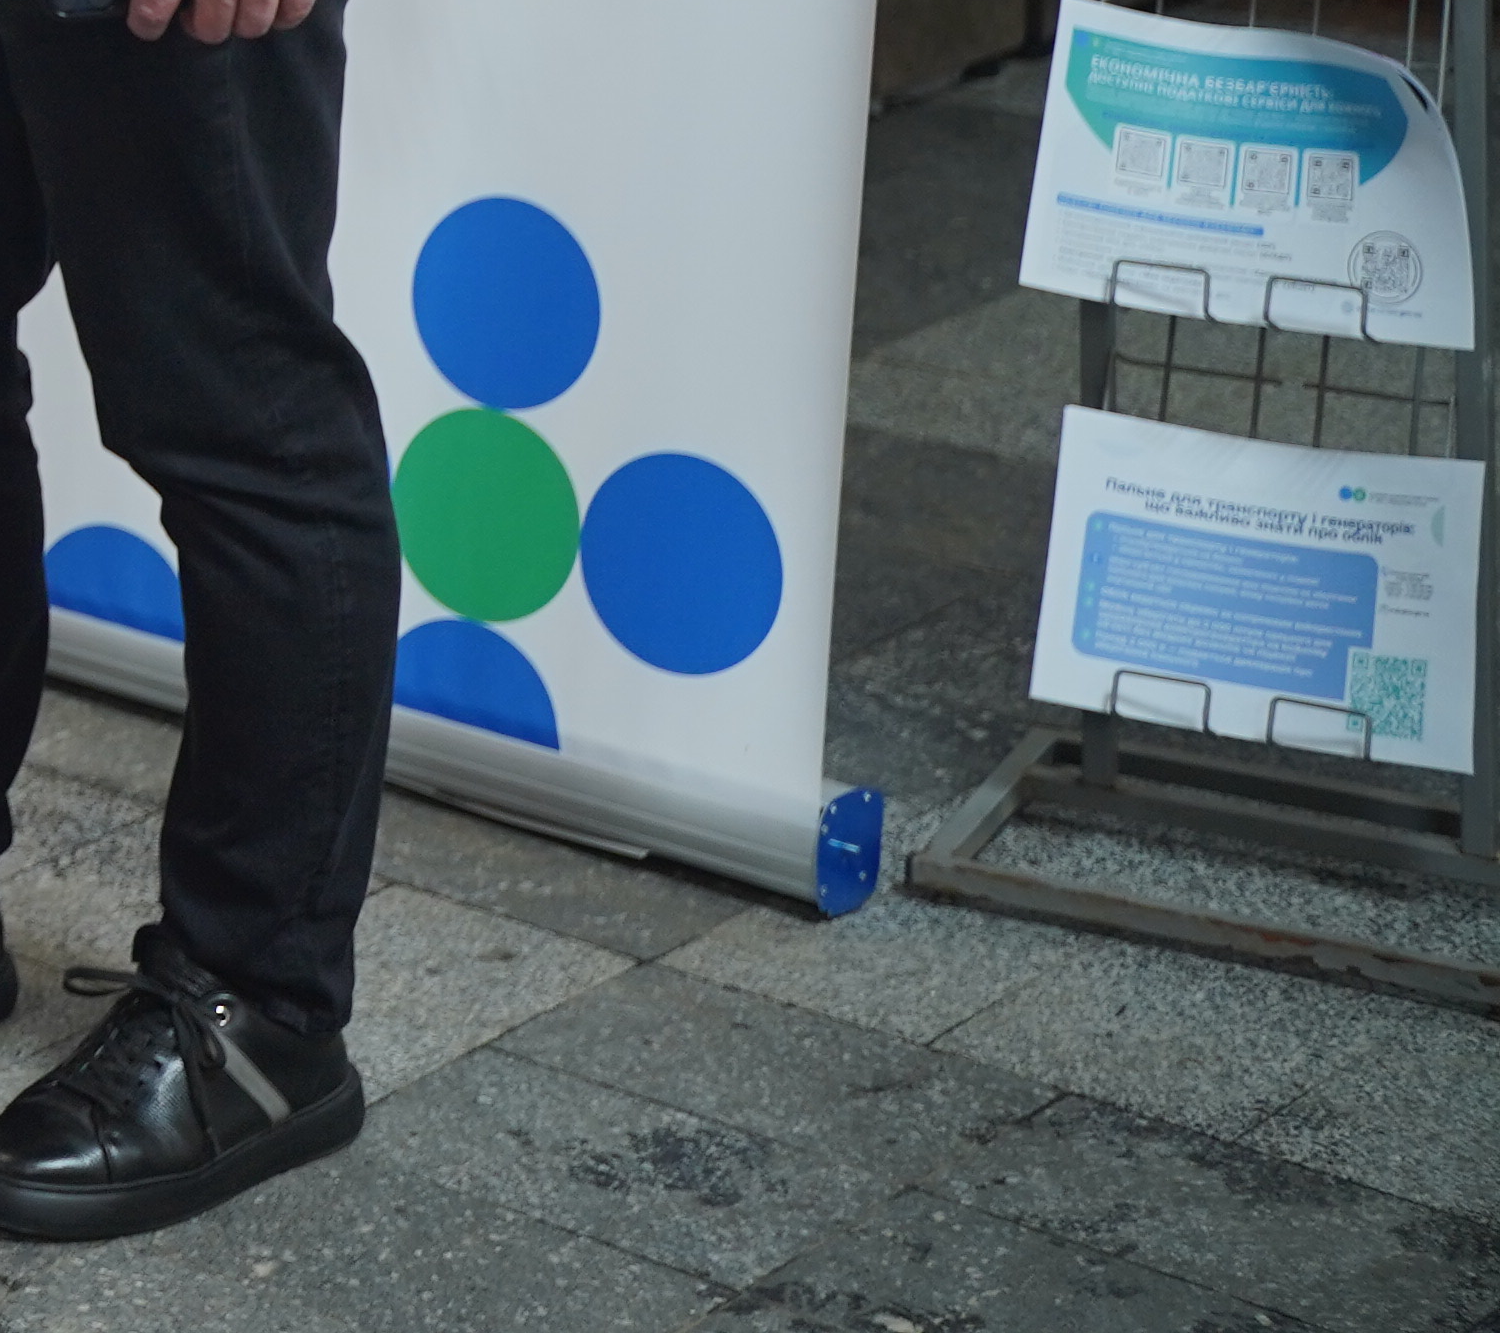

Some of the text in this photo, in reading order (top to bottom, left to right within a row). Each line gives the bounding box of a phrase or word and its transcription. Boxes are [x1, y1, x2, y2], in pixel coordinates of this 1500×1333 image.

[1090, 52, 1200, 90] ЕКОНОМІЧНА
[1106, 475, 1166, 499] Пальне
[1170, 490, 1202, 507] для
[1206, 496, 1307, 526] транспорту
[1175, 503, 1251, 528] важливо
